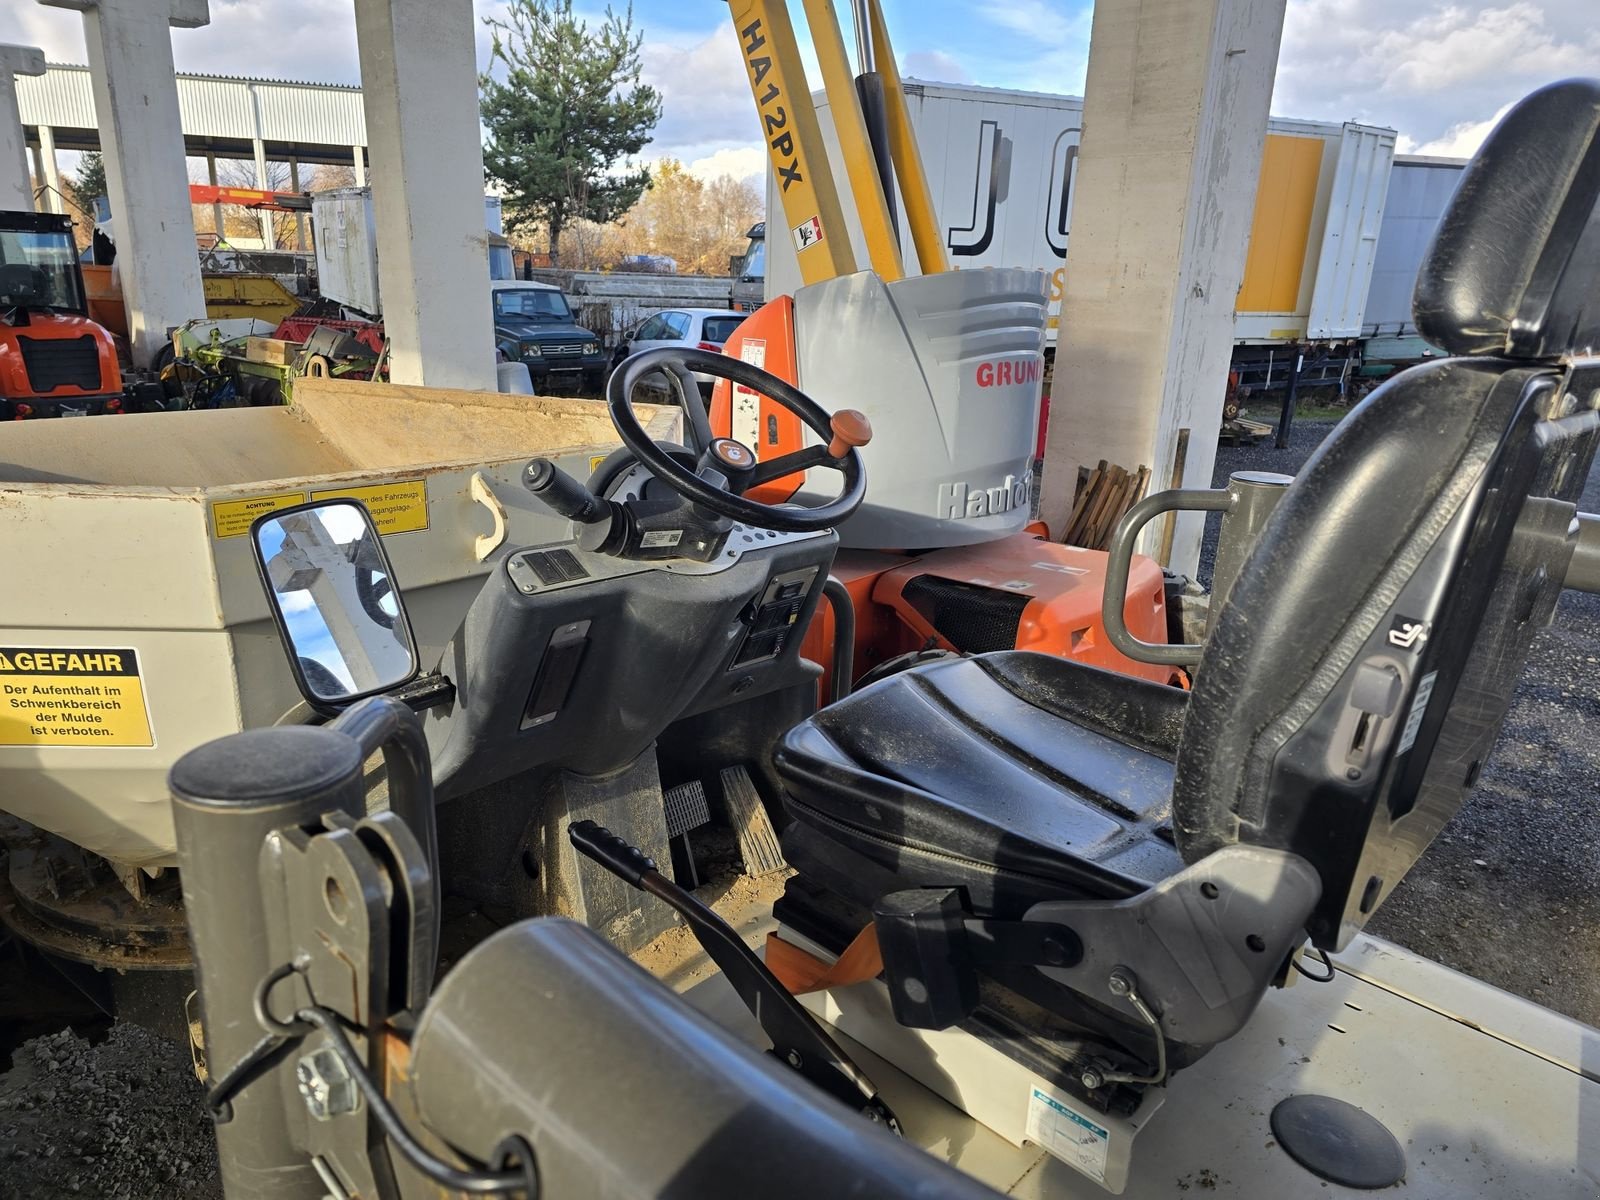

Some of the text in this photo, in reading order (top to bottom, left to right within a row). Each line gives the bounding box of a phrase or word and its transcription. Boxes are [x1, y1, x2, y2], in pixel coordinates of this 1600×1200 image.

[741, 18, 803, 193] HA12PX
[384, 491, 419, 501] Fahrzeugs
[245, 501, 276, 510] ACHTUNG
[14, 653, 123, 672] GEFAHR
[4, 684, 122, 696] Der Aufenthalt im
[10, 698, 121, 709] Schwenkbereich
[35, 713, 102, 723] der Mulde
[30, 725, 114, 736] ist verboten.
